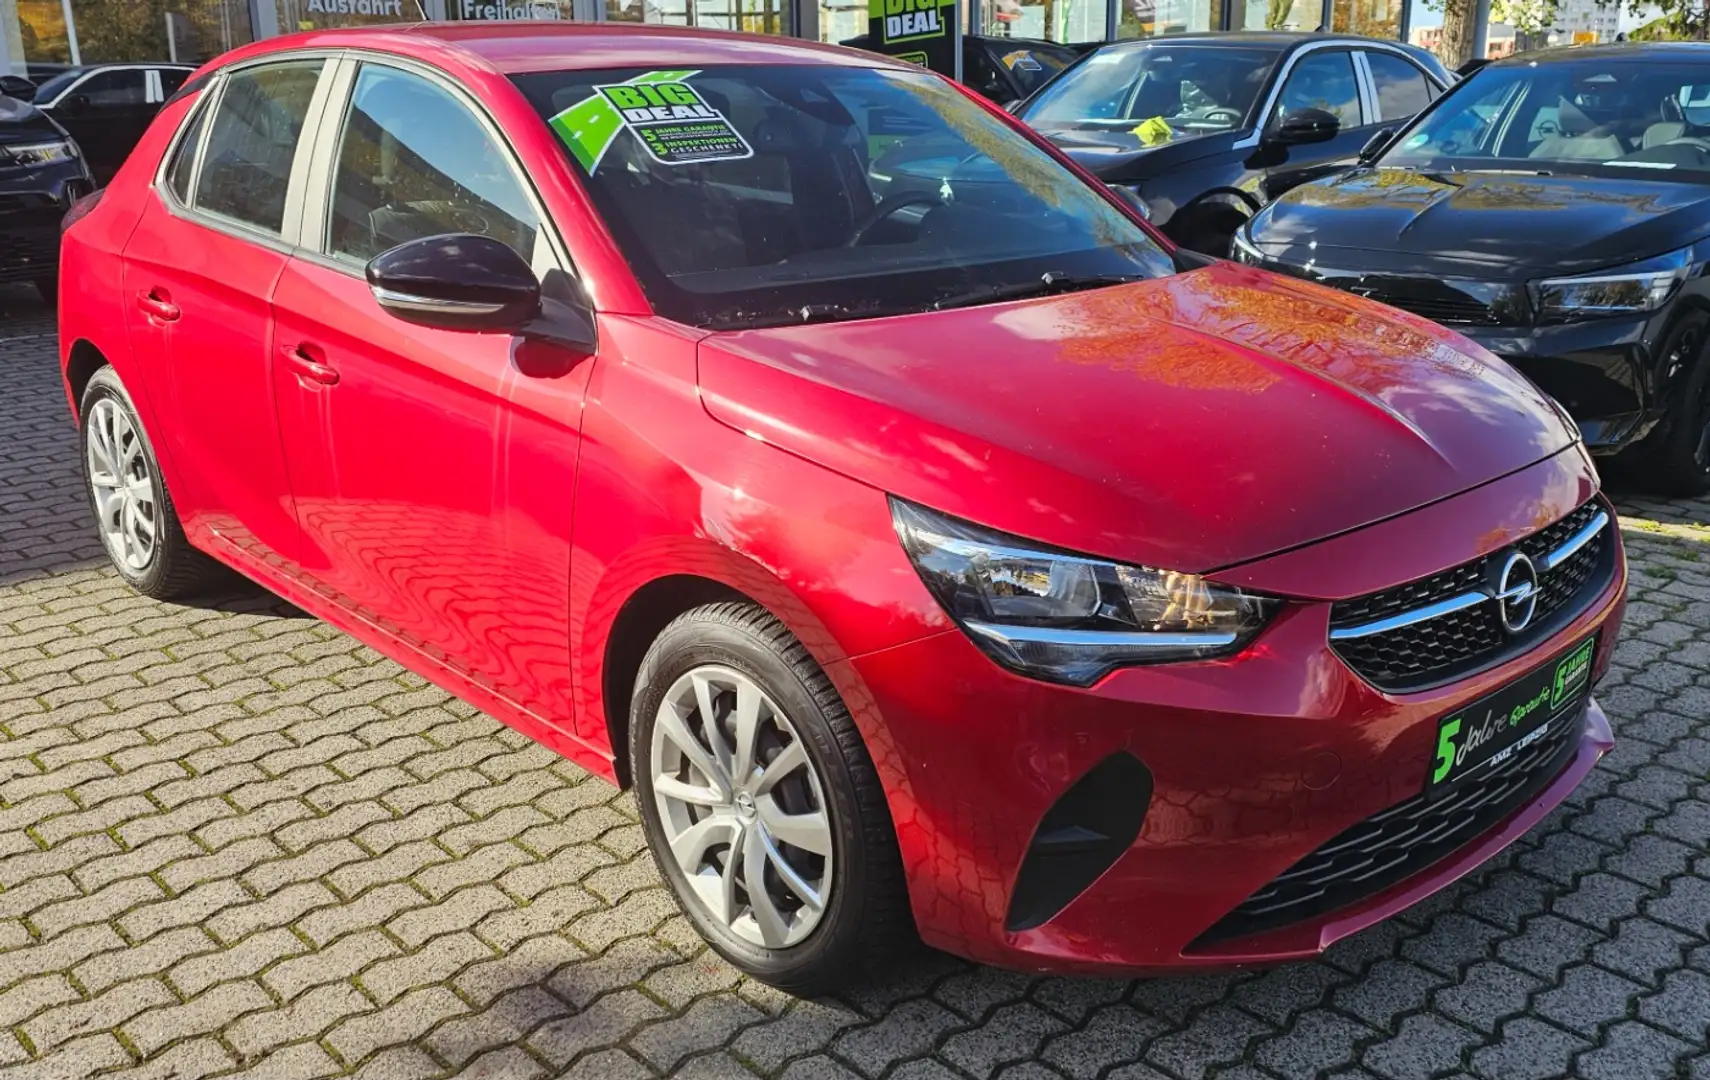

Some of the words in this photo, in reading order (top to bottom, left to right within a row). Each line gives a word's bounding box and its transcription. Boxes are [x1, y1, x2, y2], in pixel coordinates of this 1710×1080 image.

[307, 0, 402, 16] Ausfahrt
[464, 0, 561, 20] Freihaln
[886, 9, 941, 38] DEAL
[604, 84, 699, 108] BIG
[622, 105, 716, 122] DEAL
[641, 128, 657, 142] 5
[652, 142, 668, 156] 3
[1554, 665, 1567, 702] 5
[1433, 718, 1461, 784] 5
[1456, 709, 1507, 766] Jahre
